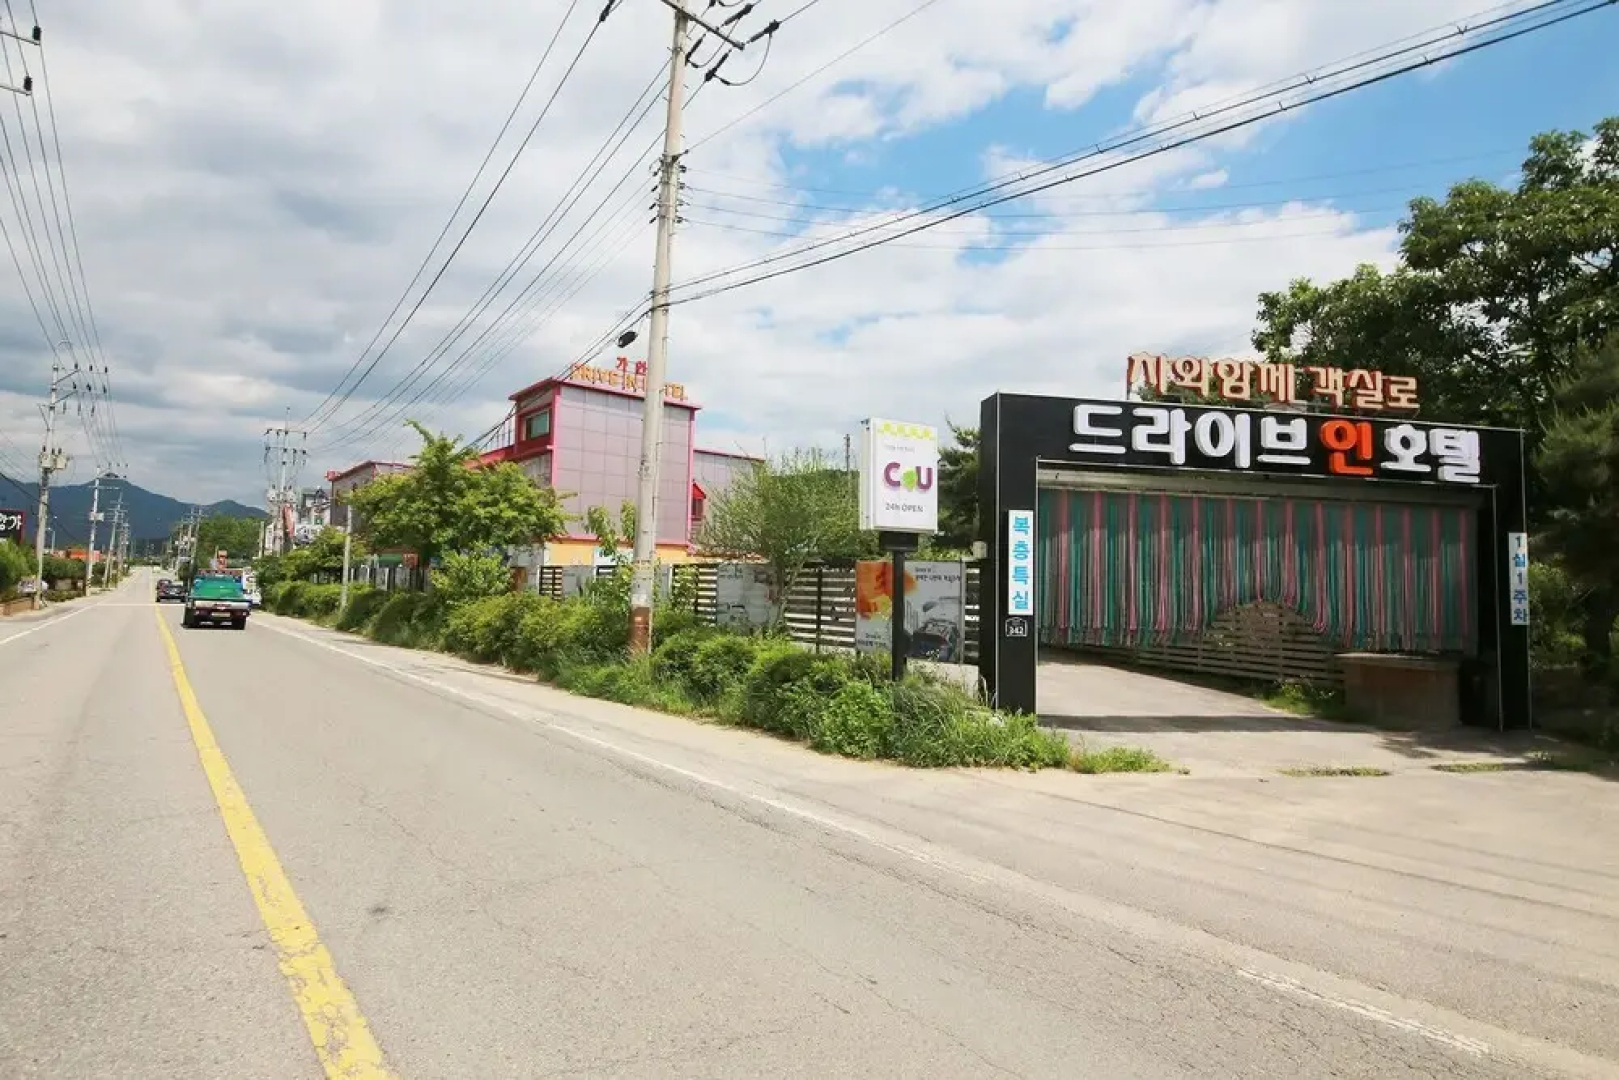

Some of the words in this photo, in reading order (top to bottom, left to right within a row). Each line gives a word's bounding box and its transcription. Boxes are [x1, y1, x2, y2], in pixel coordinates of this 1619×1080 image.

[1304, 365, 1420, 409] 객실로
[883, 461, 933, 490] CU
[902, 502, 924, 512] OPEN
